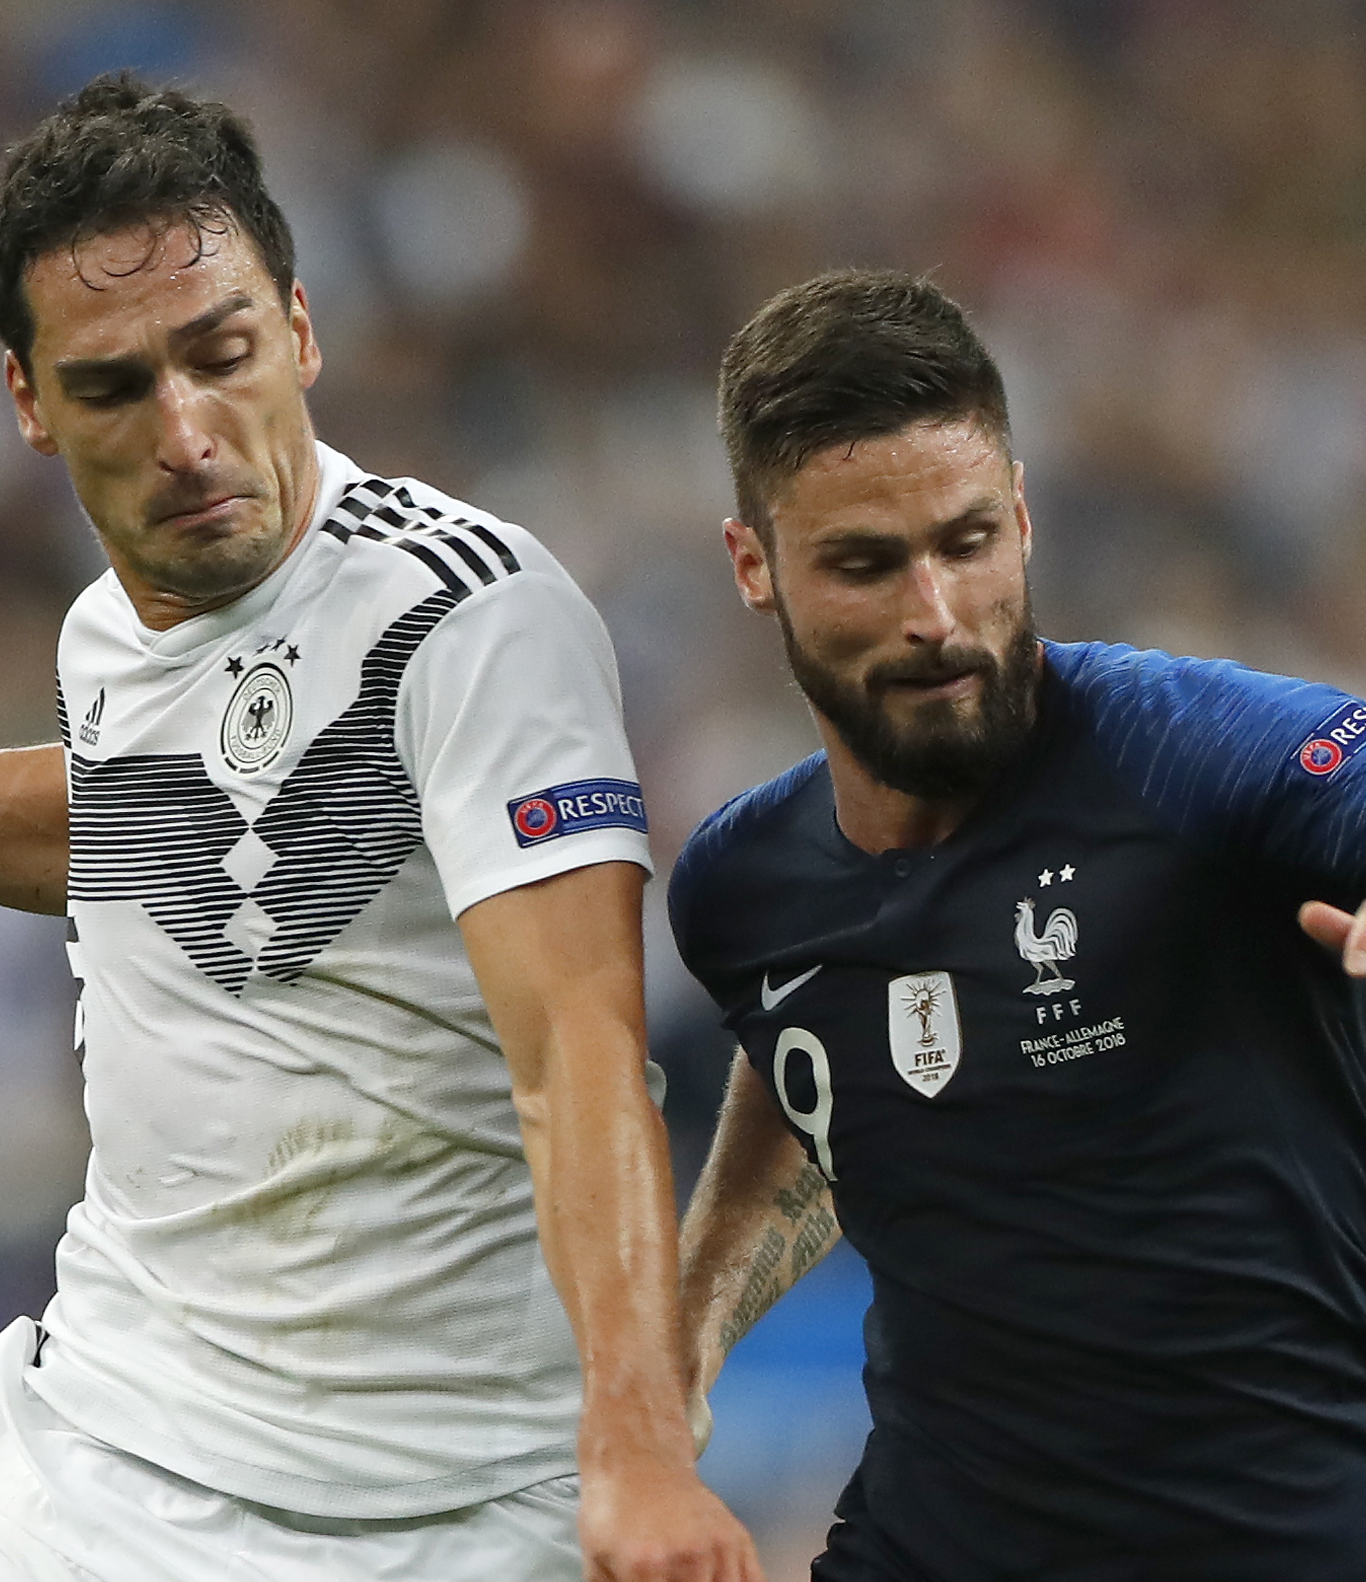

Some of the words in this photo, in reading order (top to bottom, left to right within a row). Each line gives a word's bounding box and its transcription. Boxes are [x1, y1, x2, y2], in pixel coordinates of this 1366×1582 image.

[558, 792, 643, 820] RESPECT
[1020, 1016, 1125, 1054] FRANCE-ALLEMAGNE
[1031, 1054, 1046, 1068] 16
[1047, 1042, 1095, 1065] OCTOBRE
[1095, 1033, 1126, 1052] 2018
[915, 1050, 944, 1067] FIFA
[773, 1027, 838, 1181] 9
